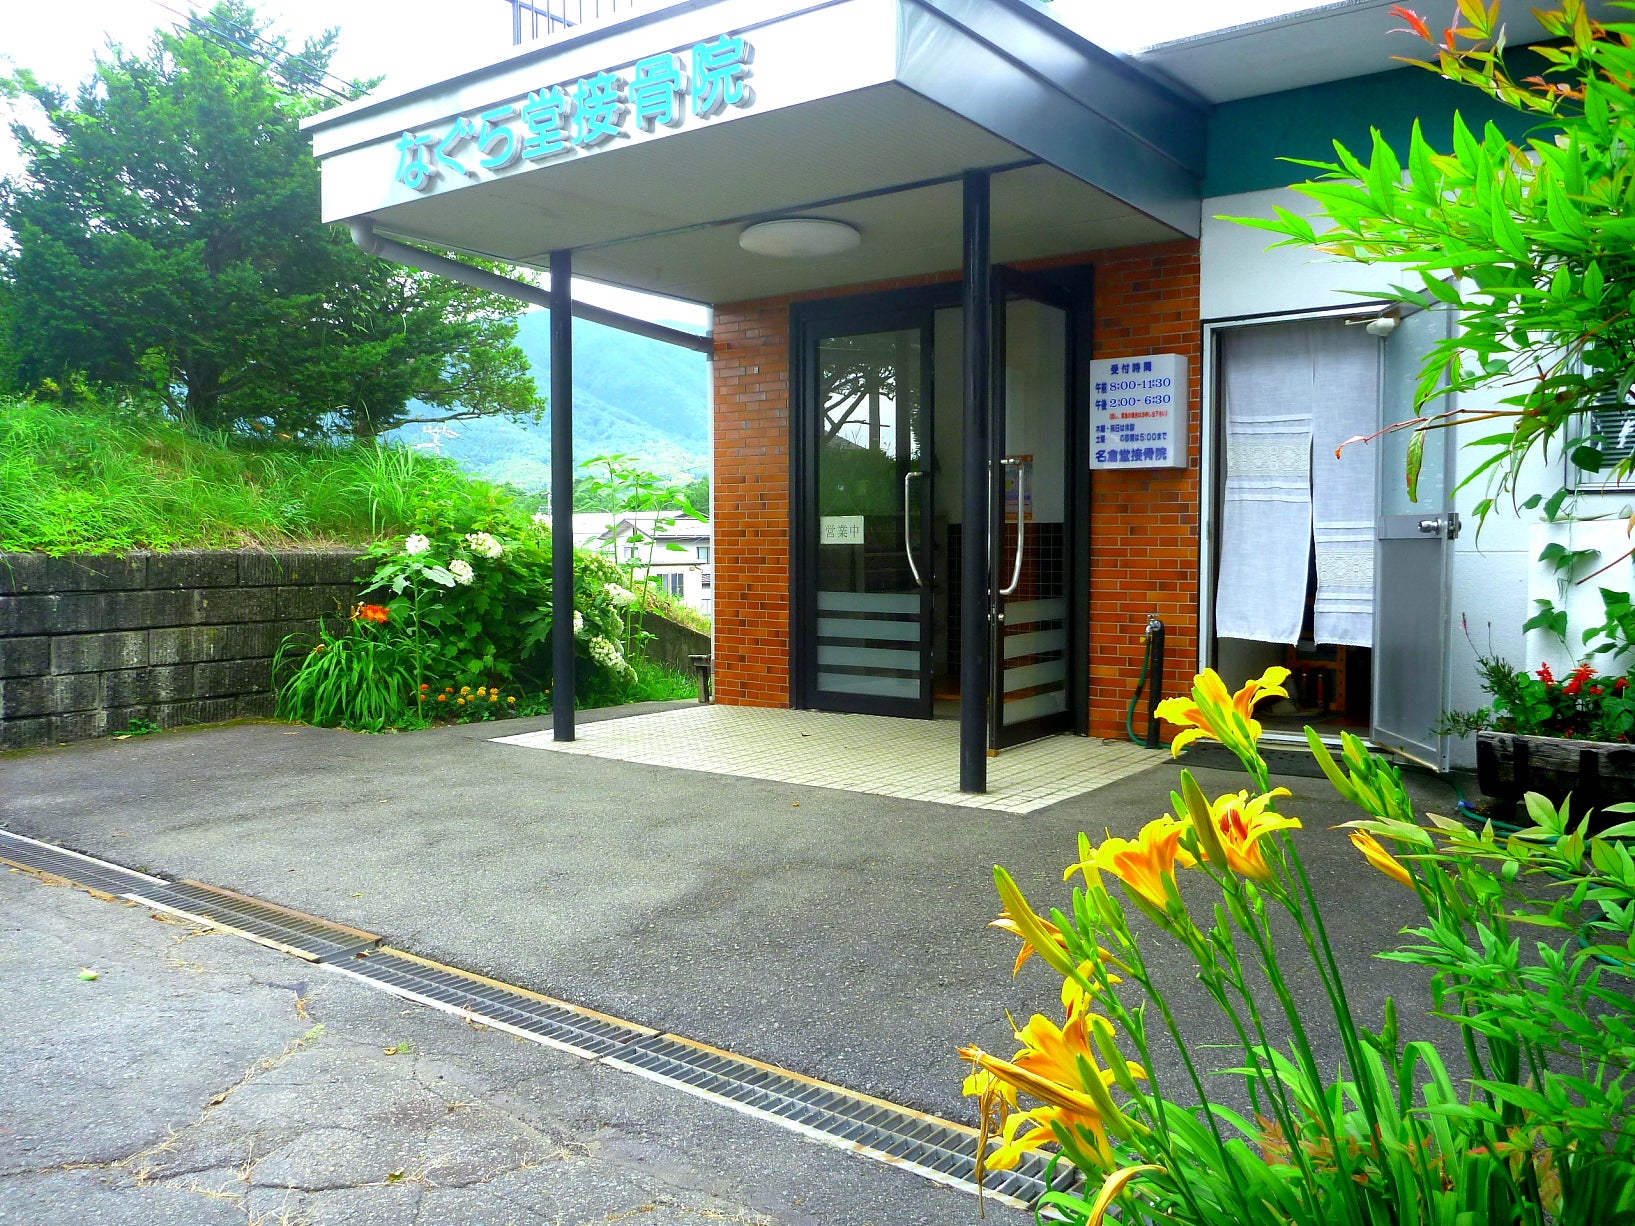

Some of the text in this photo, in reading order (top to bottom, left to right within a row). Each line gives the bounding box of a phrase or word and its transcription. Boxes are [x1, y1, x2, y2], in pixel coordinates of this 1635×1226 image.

[395, 33, 751, 191] なぐら堂接骨院
[1110, 361, 1152, 375] 受付時間
[1095, 382, 1108, 394] 午前
[1095, 399, 1108, 411] 午後
[1096, 447, 1167, 463] 名倉堂接骨院
[825, 524, 859, 538] 営業中
